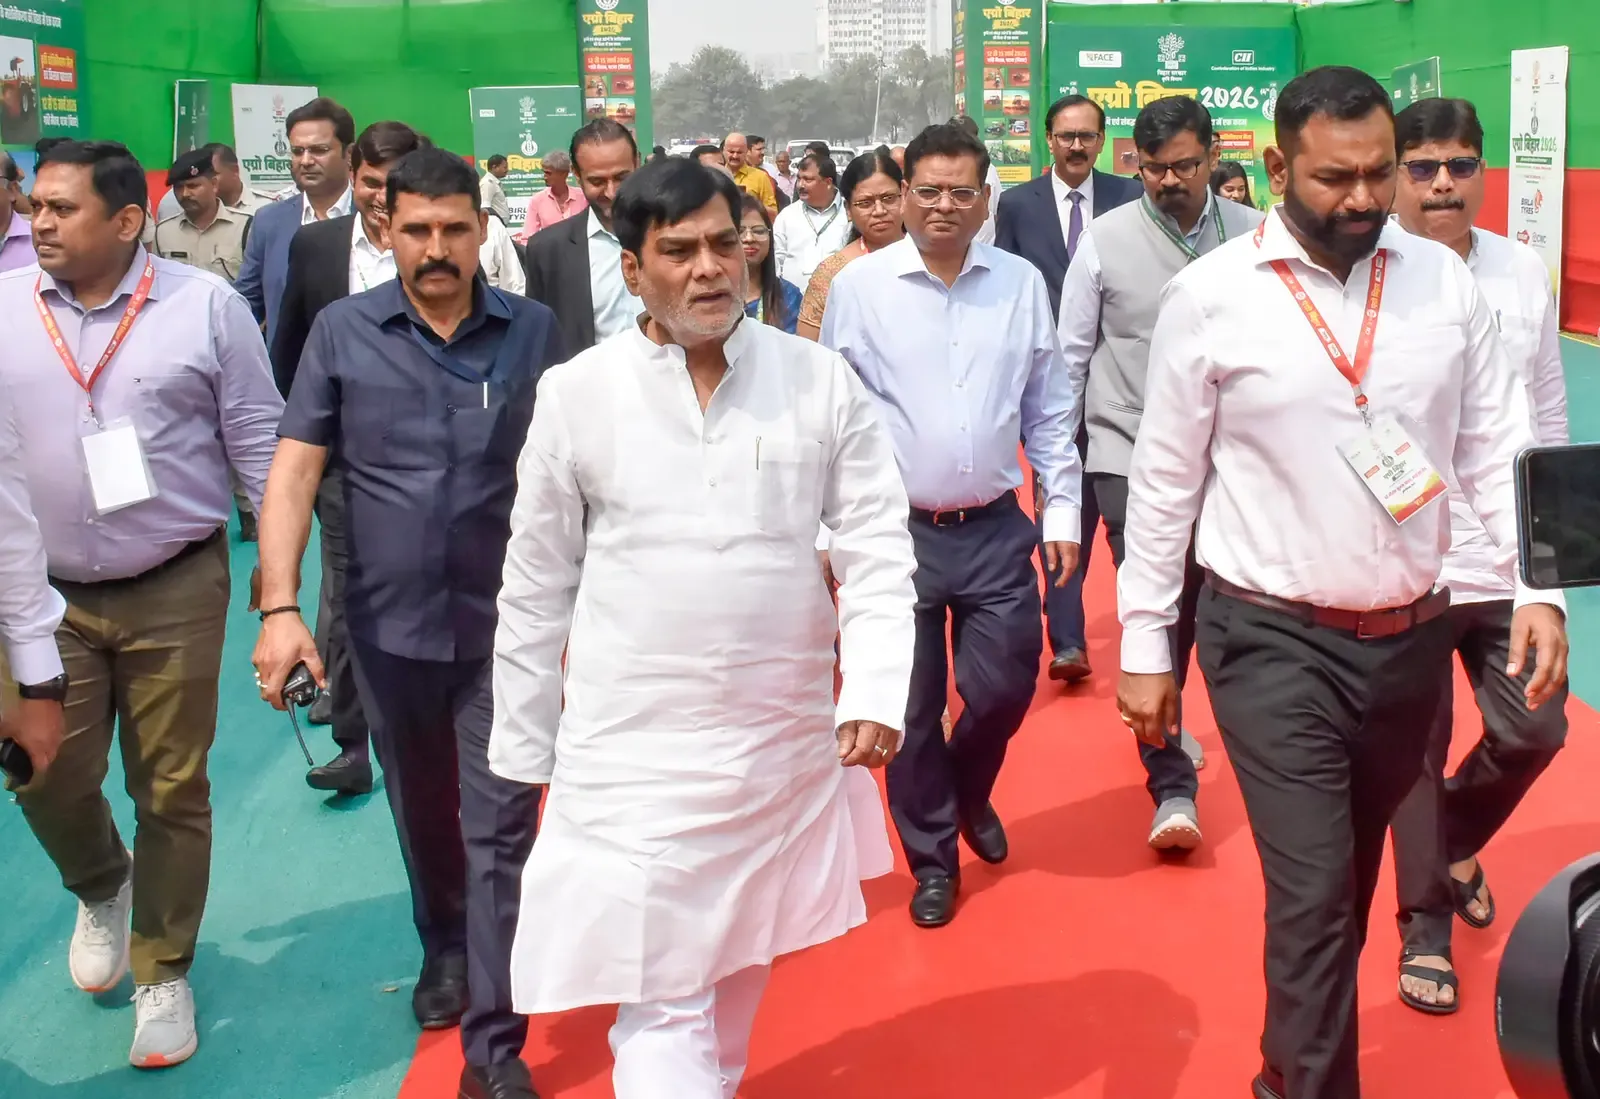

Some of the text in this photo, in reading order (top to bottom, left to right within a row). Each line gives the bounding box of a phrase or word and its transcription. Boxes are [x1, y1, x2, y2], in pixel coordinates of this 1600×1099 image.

[1094, 53, 1114, 61] FACE
[1233, 52, 1251, 62] CII
[1200, 86, 1259, 109] 2026
[242, 155, 262, 172] एग्रो
[1521, 198, 1533, 206] BIRLA
[1521, 206, 1533, 214] TYRES
